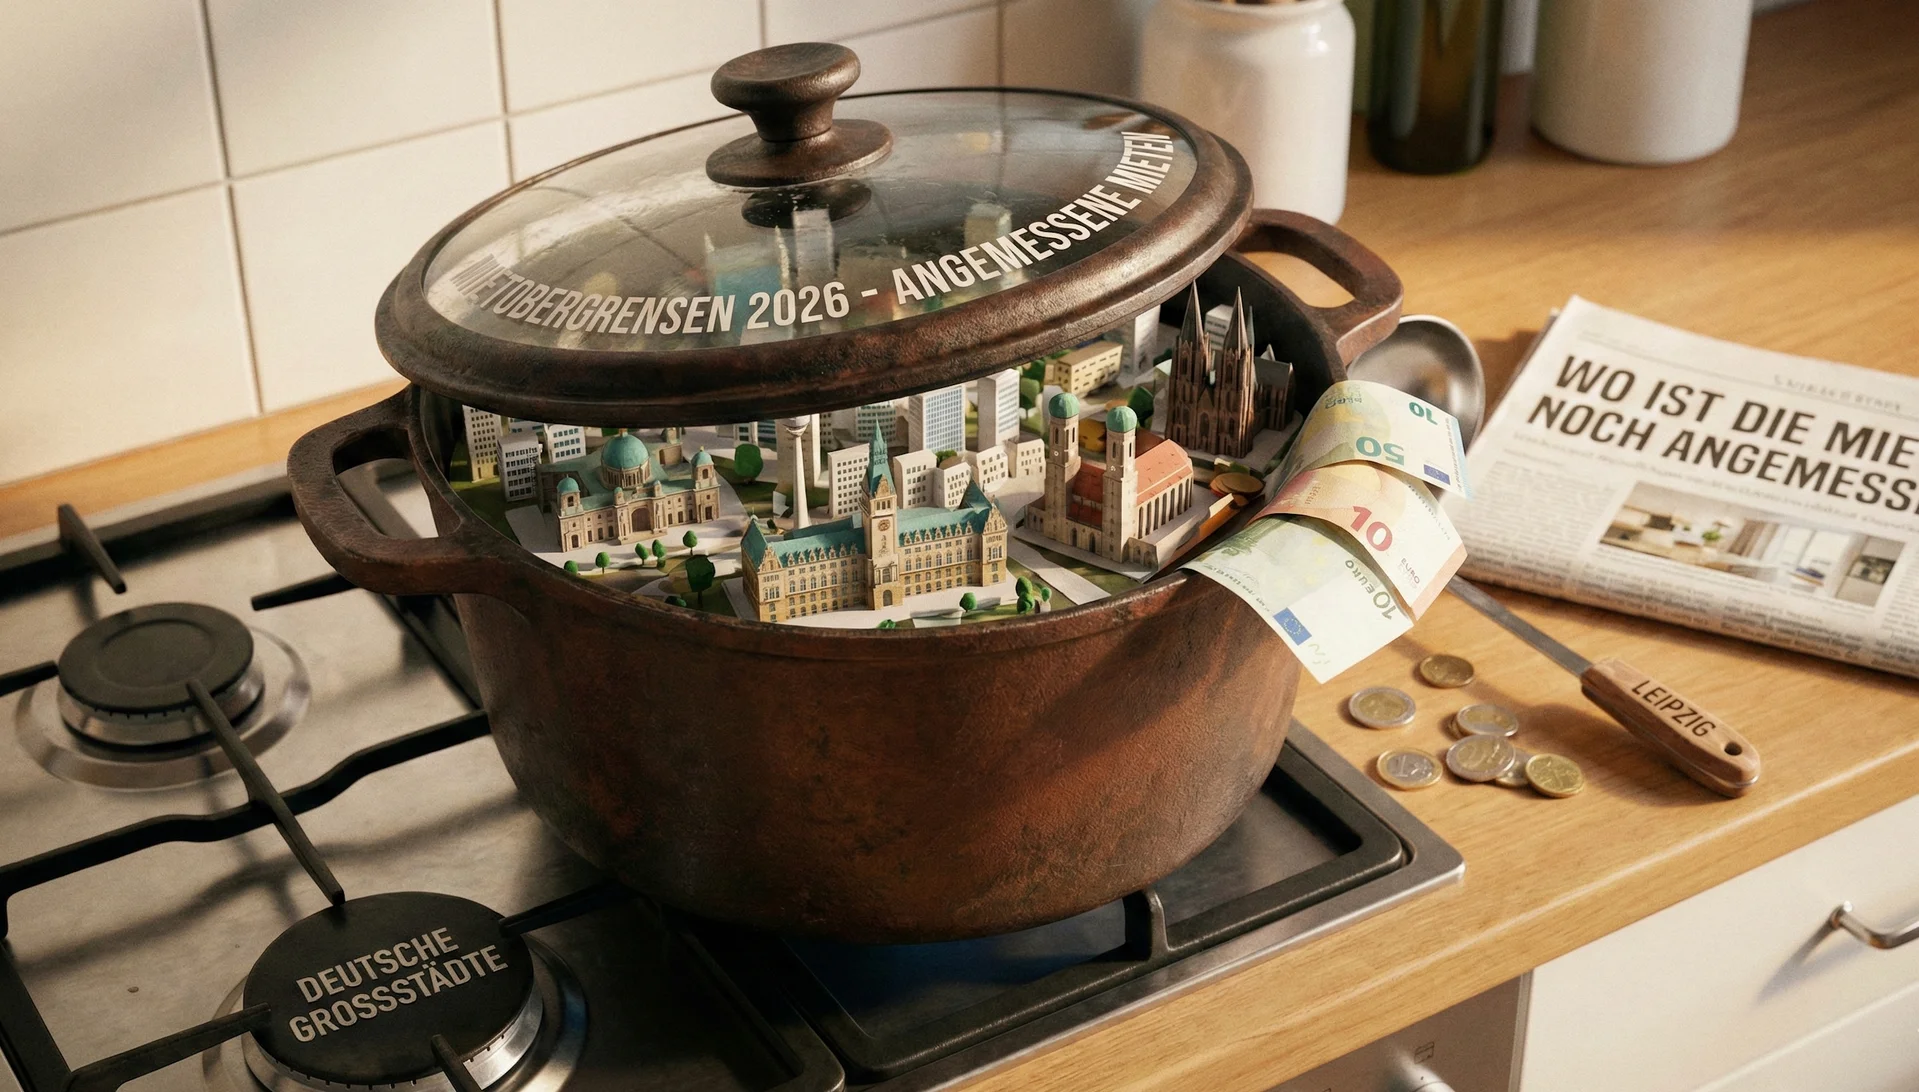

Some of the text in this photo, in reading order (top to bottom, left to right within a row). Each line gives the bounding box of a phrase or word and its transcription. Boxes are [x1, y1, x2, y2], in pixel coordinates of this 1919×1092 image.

[747, 281, 850, 330] 2026
[891, 184, 1142, 305] ANGEMESSENE
[1105, 131, 1174, 194] MIETEN
[1408, 402, 1438, 425] 10
[1555, 355, 1636, 402] WO
[1644, 380, 1725, 423] IST
[1732, 401, 1816, 445] DIE
[1824, 420, 1919, 470] MIE
[1356, 436, 1405, 466] 50
[1527, 395, 1656, 452] NOCH
[1662, 429, 1919, 515] ANGEMESS
[1351, 505, 1393, 551] 10
[1345, 559, 1399, 621] 10 EURO
[1631, 679, 1717, 738] LEIPZIG
[288, 944, 508, 1043] GROSSSTÄDTE
[296, 927, 459, 1003] DEUTSCHE
